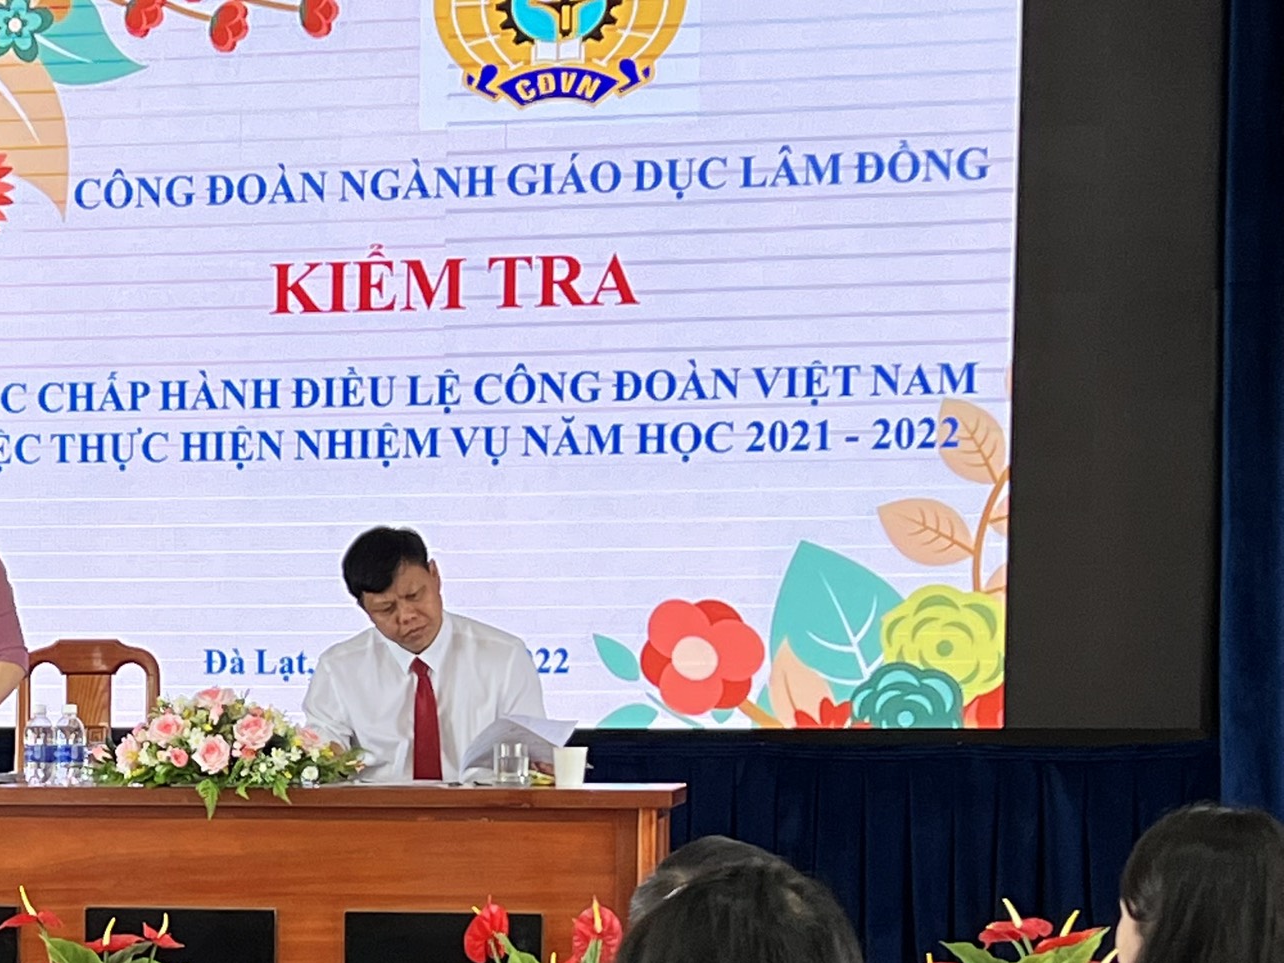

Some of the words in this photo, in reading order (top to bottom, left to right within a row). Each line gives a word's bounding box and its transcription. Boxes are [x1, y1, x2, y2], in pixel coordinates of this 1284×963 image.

[74, 168, 195, 210] CÔNG
[205, 163, 327, 206] ĐOÀN
[340, 158, 496, 202] NGÀNH
[507, 152, 623, 197] GIÁO
[634, 157, 728, 200] DỤC
[739, 144, 843, 188] LÂM
[854, 139, 990, 184] ĐỒNG
[269, 243, 468, 315] KIỂM
[487, 252, 641, 310] TRA
[37, 370, 150, 413] CHẤP
[158, 369, 282, 412] HÀNH
[291, 366, 394, 409] ĐIỀU
[405, 369, 462, 415] LỆ
[473, 362, 602, 406] CÔNG
[611, 358, 740, 402] ĐOÀN
[752, 360, 862, 408] VIỆT
[869, 361, 980, 397] NAM
[49, 426, 169, 472] THỰC
[179, 425, 285, 471] HIỆN
[294, 422, 442, 468] NHIỆM
[449, 424, 511, 467] VỤ
[520, 415, 623, 457] NĂM
[635, 420, 735, 464] HỌC
[745, 418, 832, 453] 2021
[870, 415, 960, 450] 2022
[203, 647, 246, 675] Đà
[526, 647, 570, 674] 22
